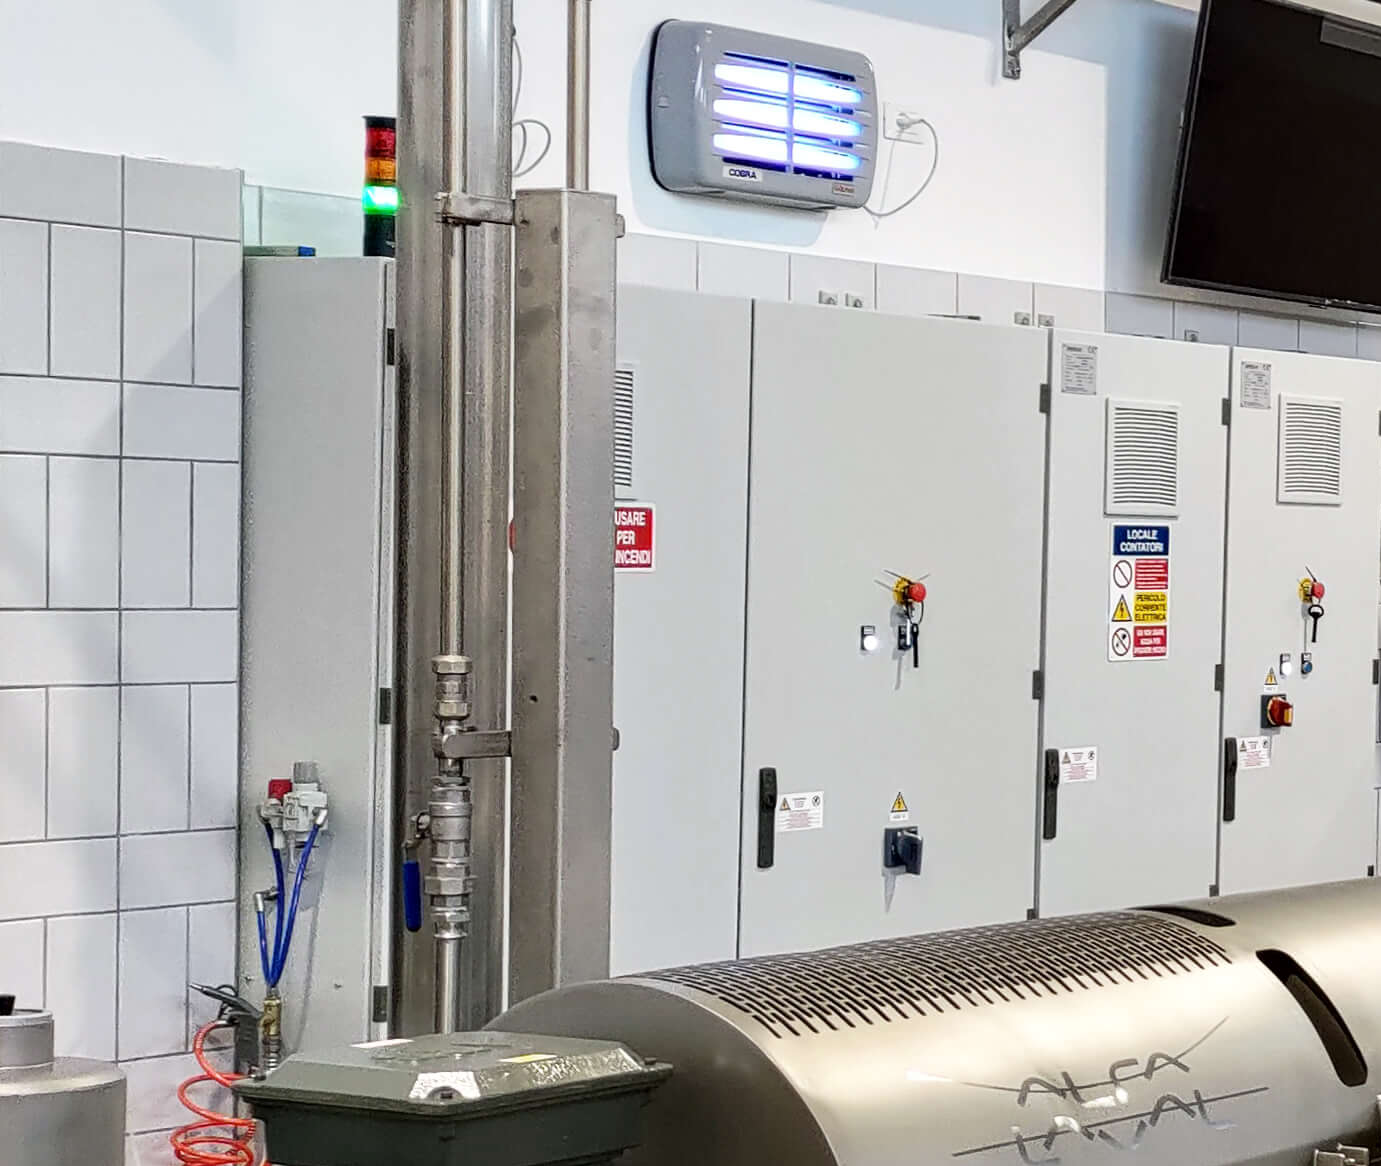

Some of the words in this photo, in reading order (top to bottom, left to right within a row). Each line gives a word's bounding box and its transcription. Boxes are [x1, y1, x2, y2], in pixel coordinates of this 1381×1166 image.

[728, 168, 757, 179] COBRA
[614, 511, 646, 526] USARE
[616, 530, 636, 545] PER
[1127, 529, 1158, 540] LOCALE
[1120, 542, 1164, 553] CONTATORI
[1016, 1052, 1191, 1108] ALFA
